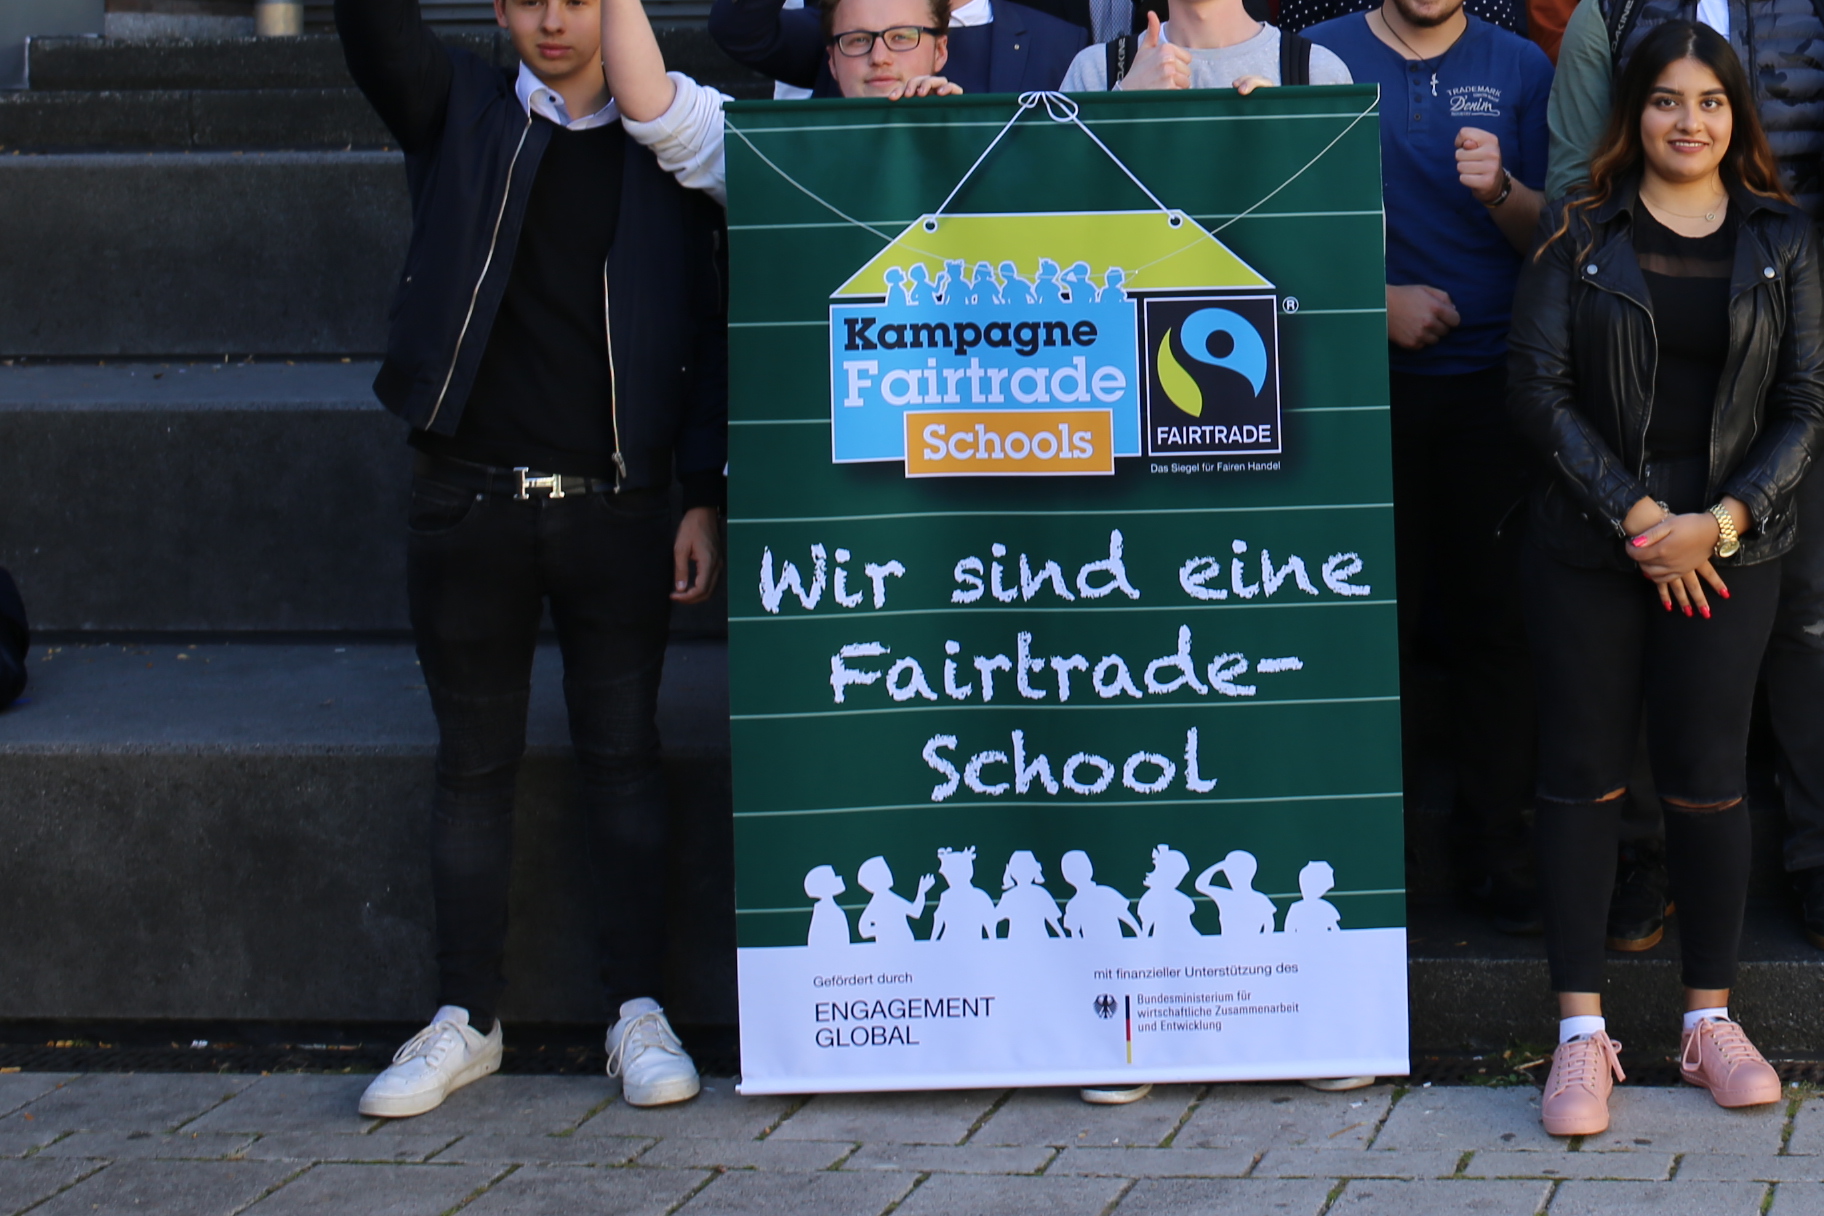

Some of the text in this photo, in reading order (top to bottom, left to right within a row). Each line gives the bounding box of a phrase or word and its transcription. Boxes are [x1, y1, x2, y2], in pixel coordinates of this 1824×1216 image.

[1611, 0, 1635, 54] DAKINE
[1446, 85, 1502, 97] TRADEMARK
[843, 317, 1098, 357] Kampagne
[843, 357, 1126, 407] Fairtrade
[922, 422, 1094, 461] Schools
[1157, 424, 1272, 445] FAIRTRADE
[1150, 461, 1281, 474] Das Siegel für Fairen Handel
[759, 529, 1371, 614] Wir sind eine
[829, 624, 1304, 704] Fairtrade-
[922, 727, 1217, 802] School
[813, 971, 913, 987] Gefördert durch
[1094, 962, 1299, 980] mit finanzieller Unterstützung des
[1137, 989, 1251, 1005] Bundesministerium für
[815, 996, 995, 1022] ENGAGEMENT
[1137, 1002, 1299, 1018] wirtschaftliche Zusammenarbeit
[815, 1025, 920, 1048] GLOBAL
[1138, 1019, 1222, 1032] und Entwicklung
